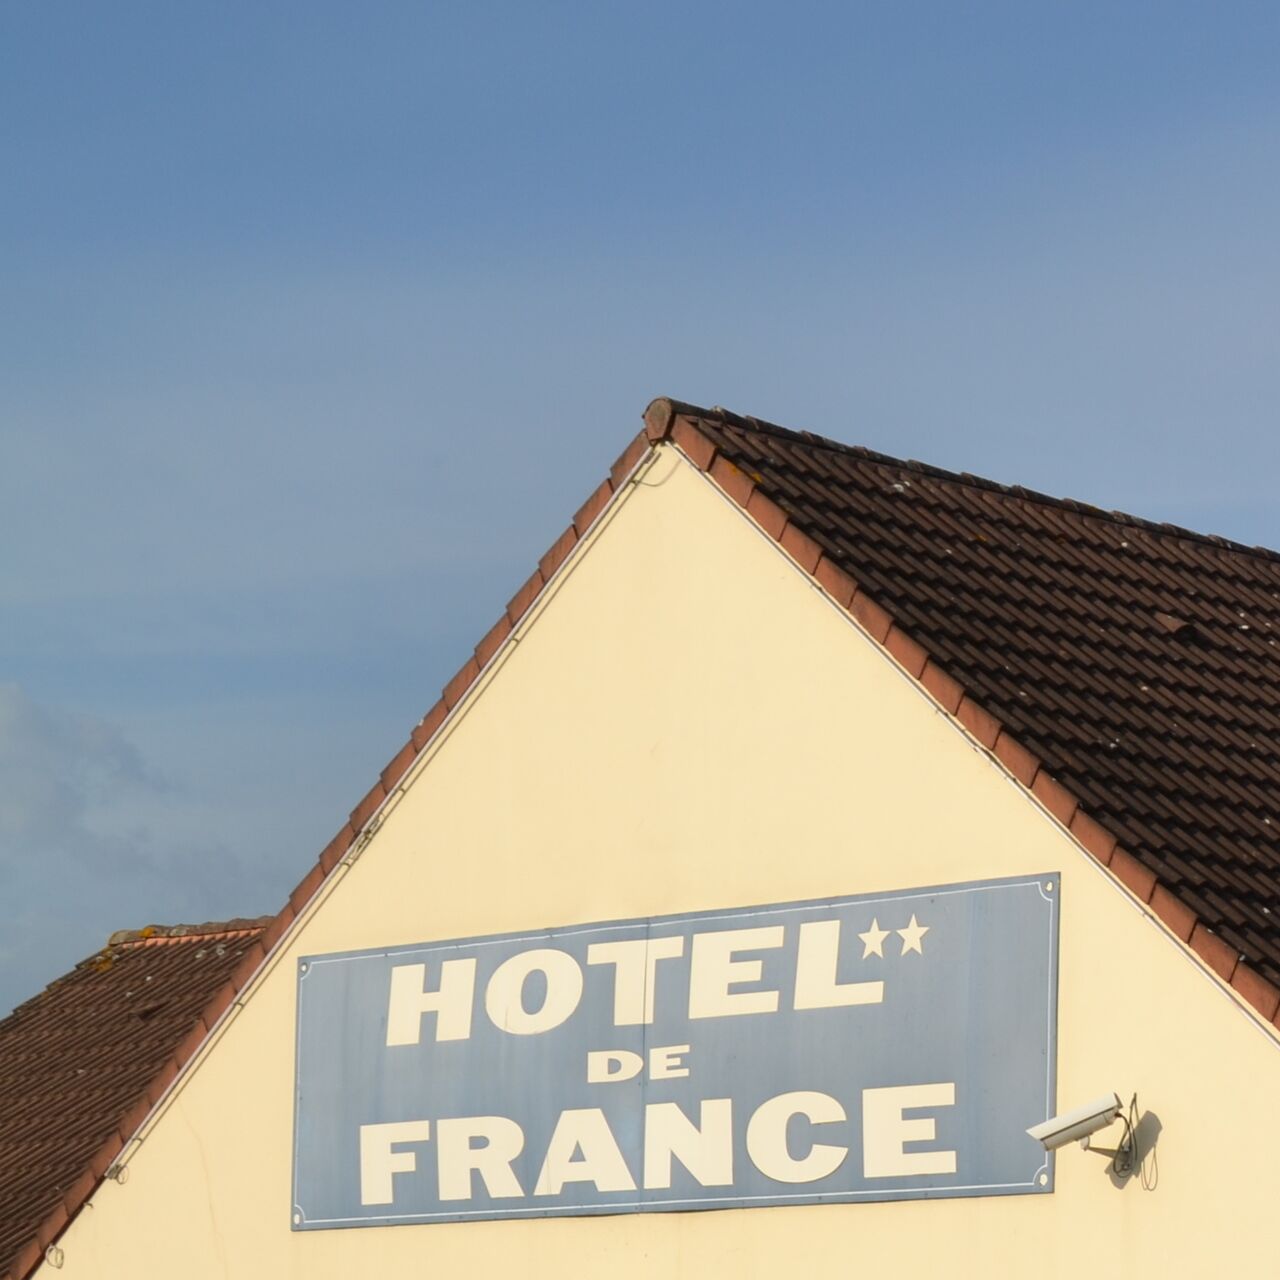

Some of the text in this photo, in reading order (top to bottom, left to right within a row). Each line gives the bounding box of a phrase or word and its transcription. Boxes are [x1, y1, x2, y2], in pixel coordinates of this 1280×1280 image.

[386, 919, 885, 1047] HOTEL
[587, 1044, 690, 1083] DE
[360, 1082, 957, 1205] FRANCE
